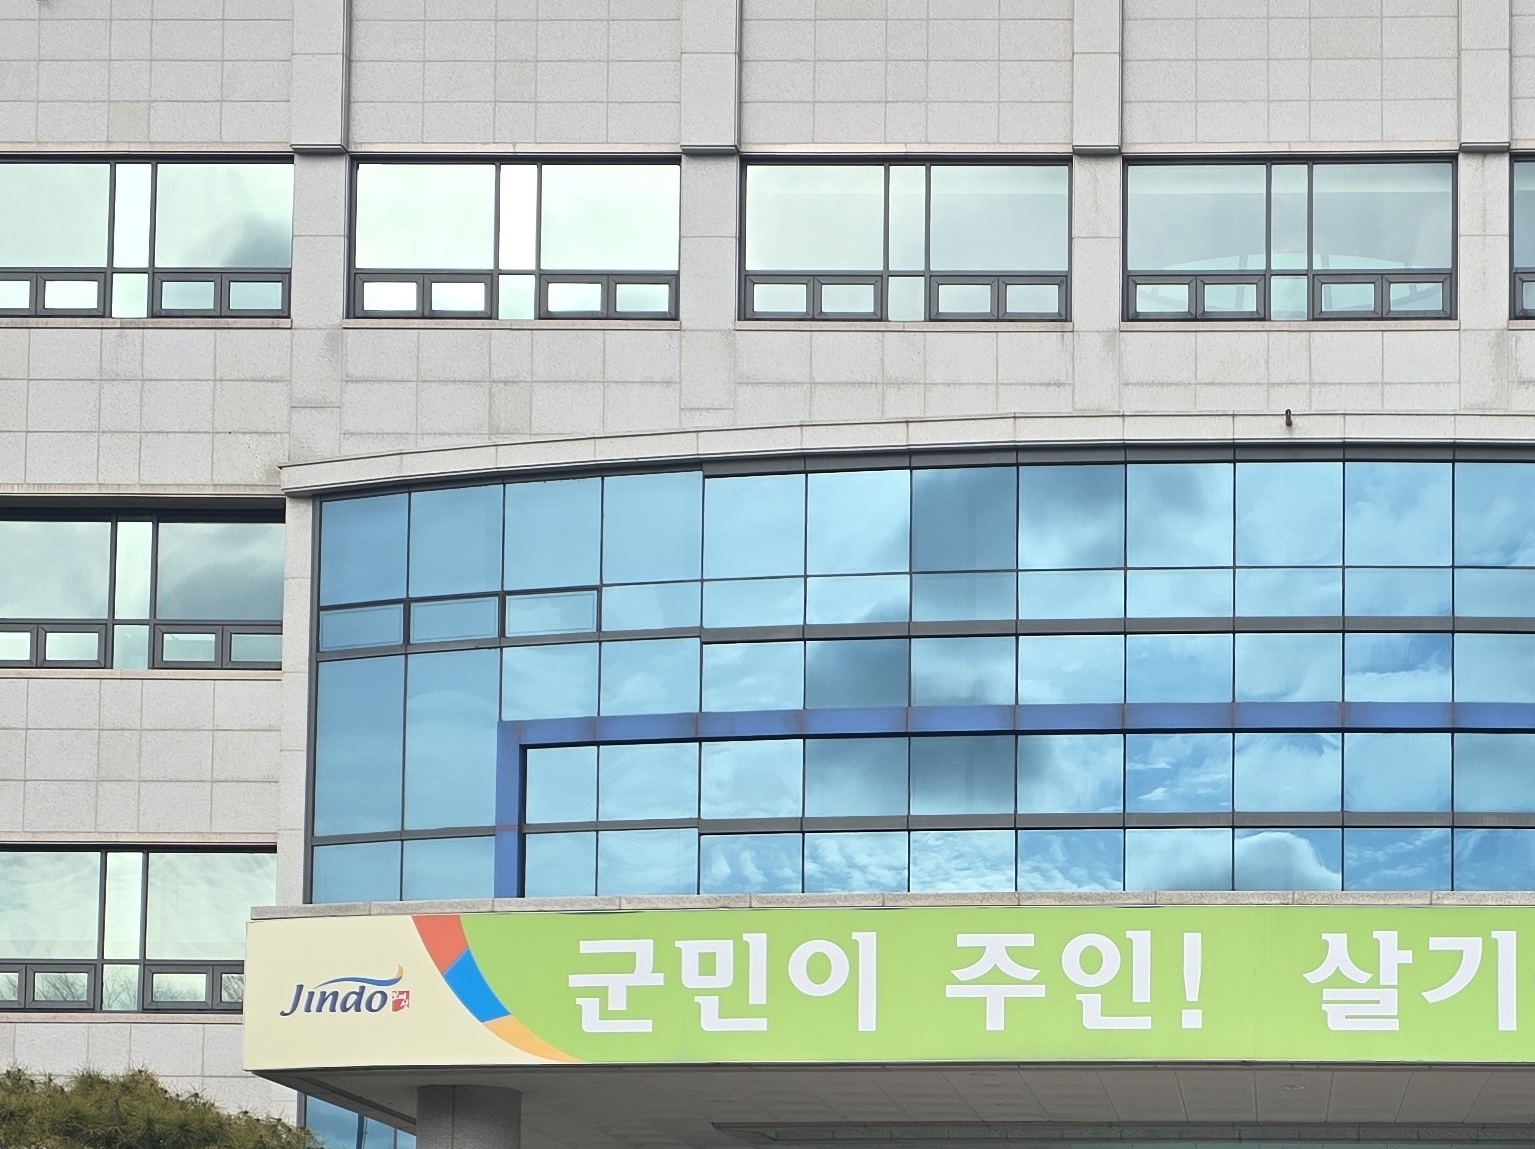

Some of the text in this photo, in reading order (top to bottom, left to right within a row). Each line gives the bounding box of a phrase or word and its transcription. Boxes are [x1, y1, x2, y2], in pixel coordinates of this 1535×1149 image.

[280, 980, 389, 1018] Jindo
[568, 931, 877, 1034] 군민이
[946, 929, 1204, 1031] 주인!
